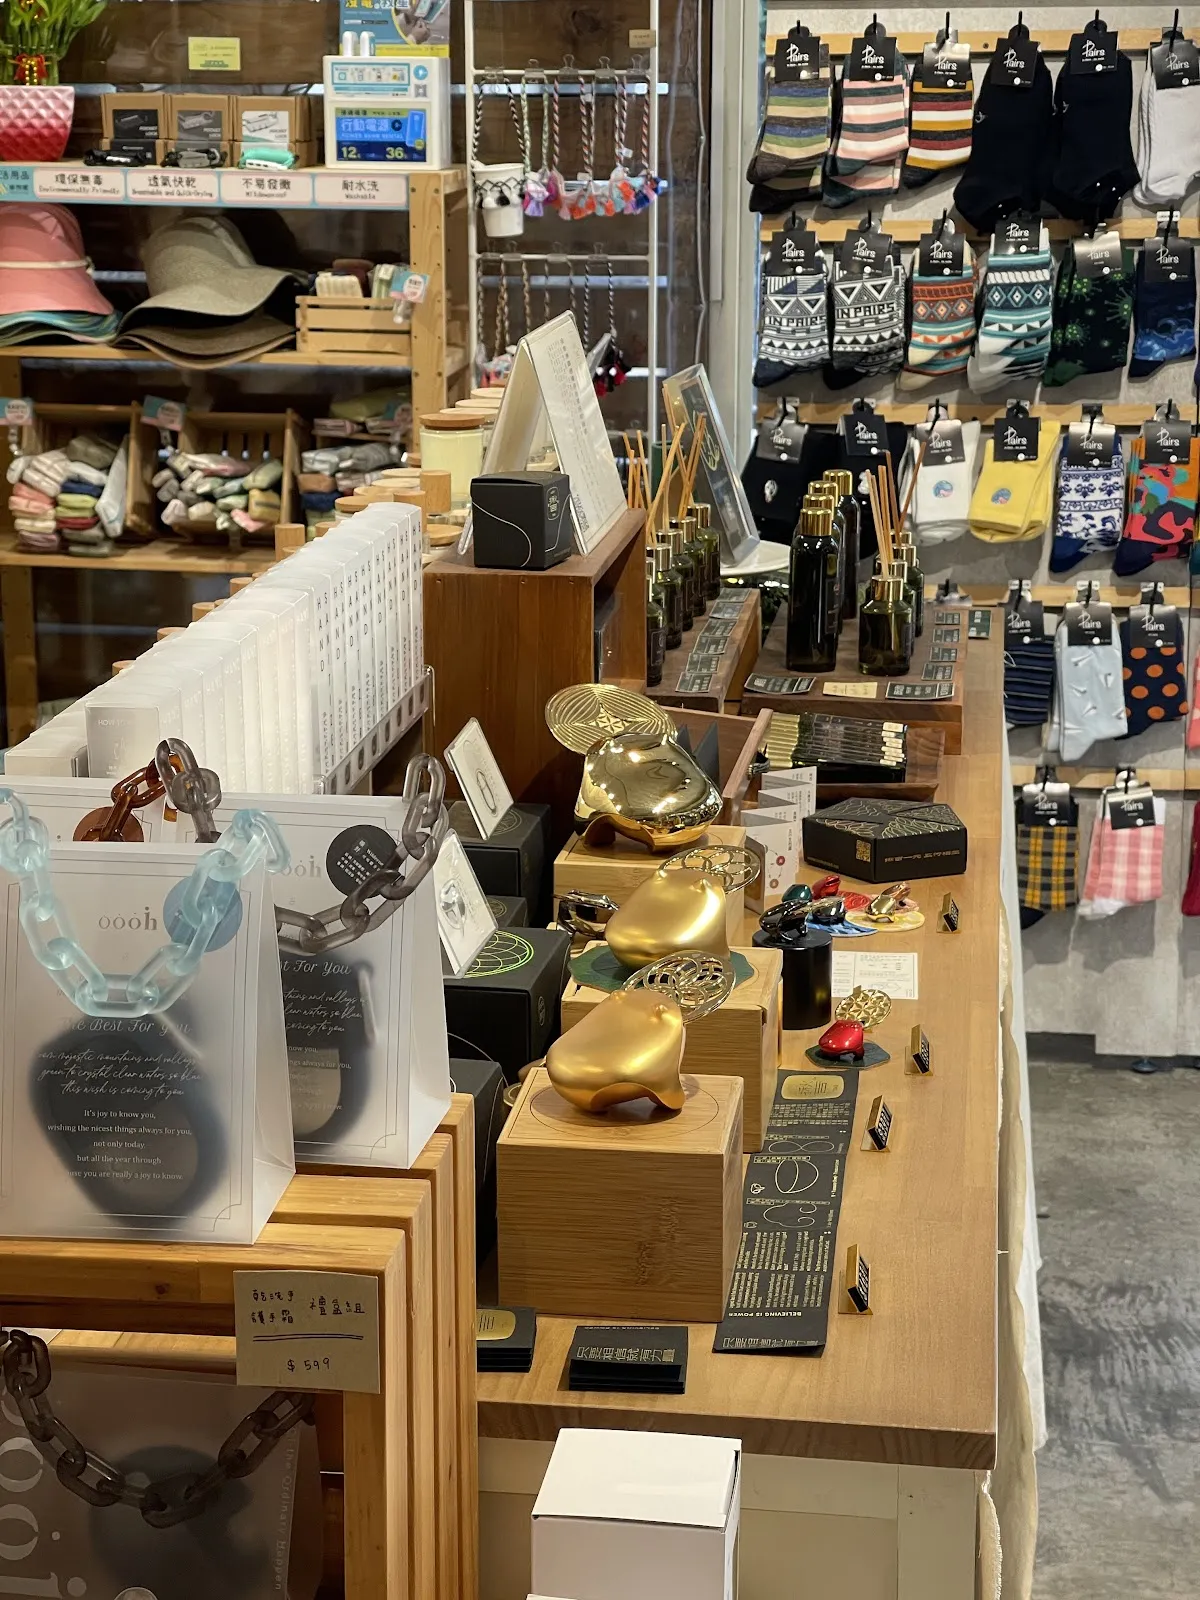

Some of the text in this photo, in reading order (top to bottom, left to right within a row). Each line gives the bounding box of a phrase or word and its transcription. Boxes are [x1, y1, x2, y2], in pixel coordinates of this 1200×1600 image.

[786, 43, 809, 62] Pairs
[862, 44, 885, 65] Pairs
[1082, 40, 1105, 57] Pairs
[935, 51, 957, 70] Pairs
[1004, 47, 1025, 69] Pairs
[1166, 52, 1190, 70] Pairs
[341, 146, 357, 158] 12
[385, 147, 404, 159] 36
[55, 174, 103, 186] 環保無毒
[147, 176, 197, 188] 透氣快乾
[342, 180, 379, 192] 耐水洗
[1006, 222, 1030, 238] Pairs
[782, 238, 805, 257] Pairs
[854, 237, 876, 258] Pairs
[930, 240, 953, 259] Pairs
[1156, 244, 1180, 264] Pairs
[837, 302, 895, 319] IN PAIRS
[769, 317, 783, 327] IN
[854, 421, 878, 440] Pairs
[1004, 426, 1027, 445] Pairs
[1156, 427, 1180, 446] Pairs
[929, 432, 952, 449] Pairs
[1079, 433, 1103, 450] Pairs
[294, 960, 318, 972] For
[322, 961, 351, 976] You
[89, 1019, 123, 1032] Best
[128, 1020, 154, 1033] For
[84, 1109, 96, 1117] It's
[97, 1110, 108, 1119] joy
[119, 1110, 139, 1118] know
[48, 1124, 76, 1132] wishing
[114, 1126, 137, 1134] things
[138, 1126, 162, 1134] always
[176, 1128, 192, 1136] you,
[107, 1140, 122, 1149] only
[77, 1154, 89, 1162] but
[91, 1154, 101, 1162] all
[115, 1156, 131, 1164] year
[132, 1156, 162, 1165] through
[112, 1171, 132, 1179] really
[139, 1172, 151, 1180] joy
